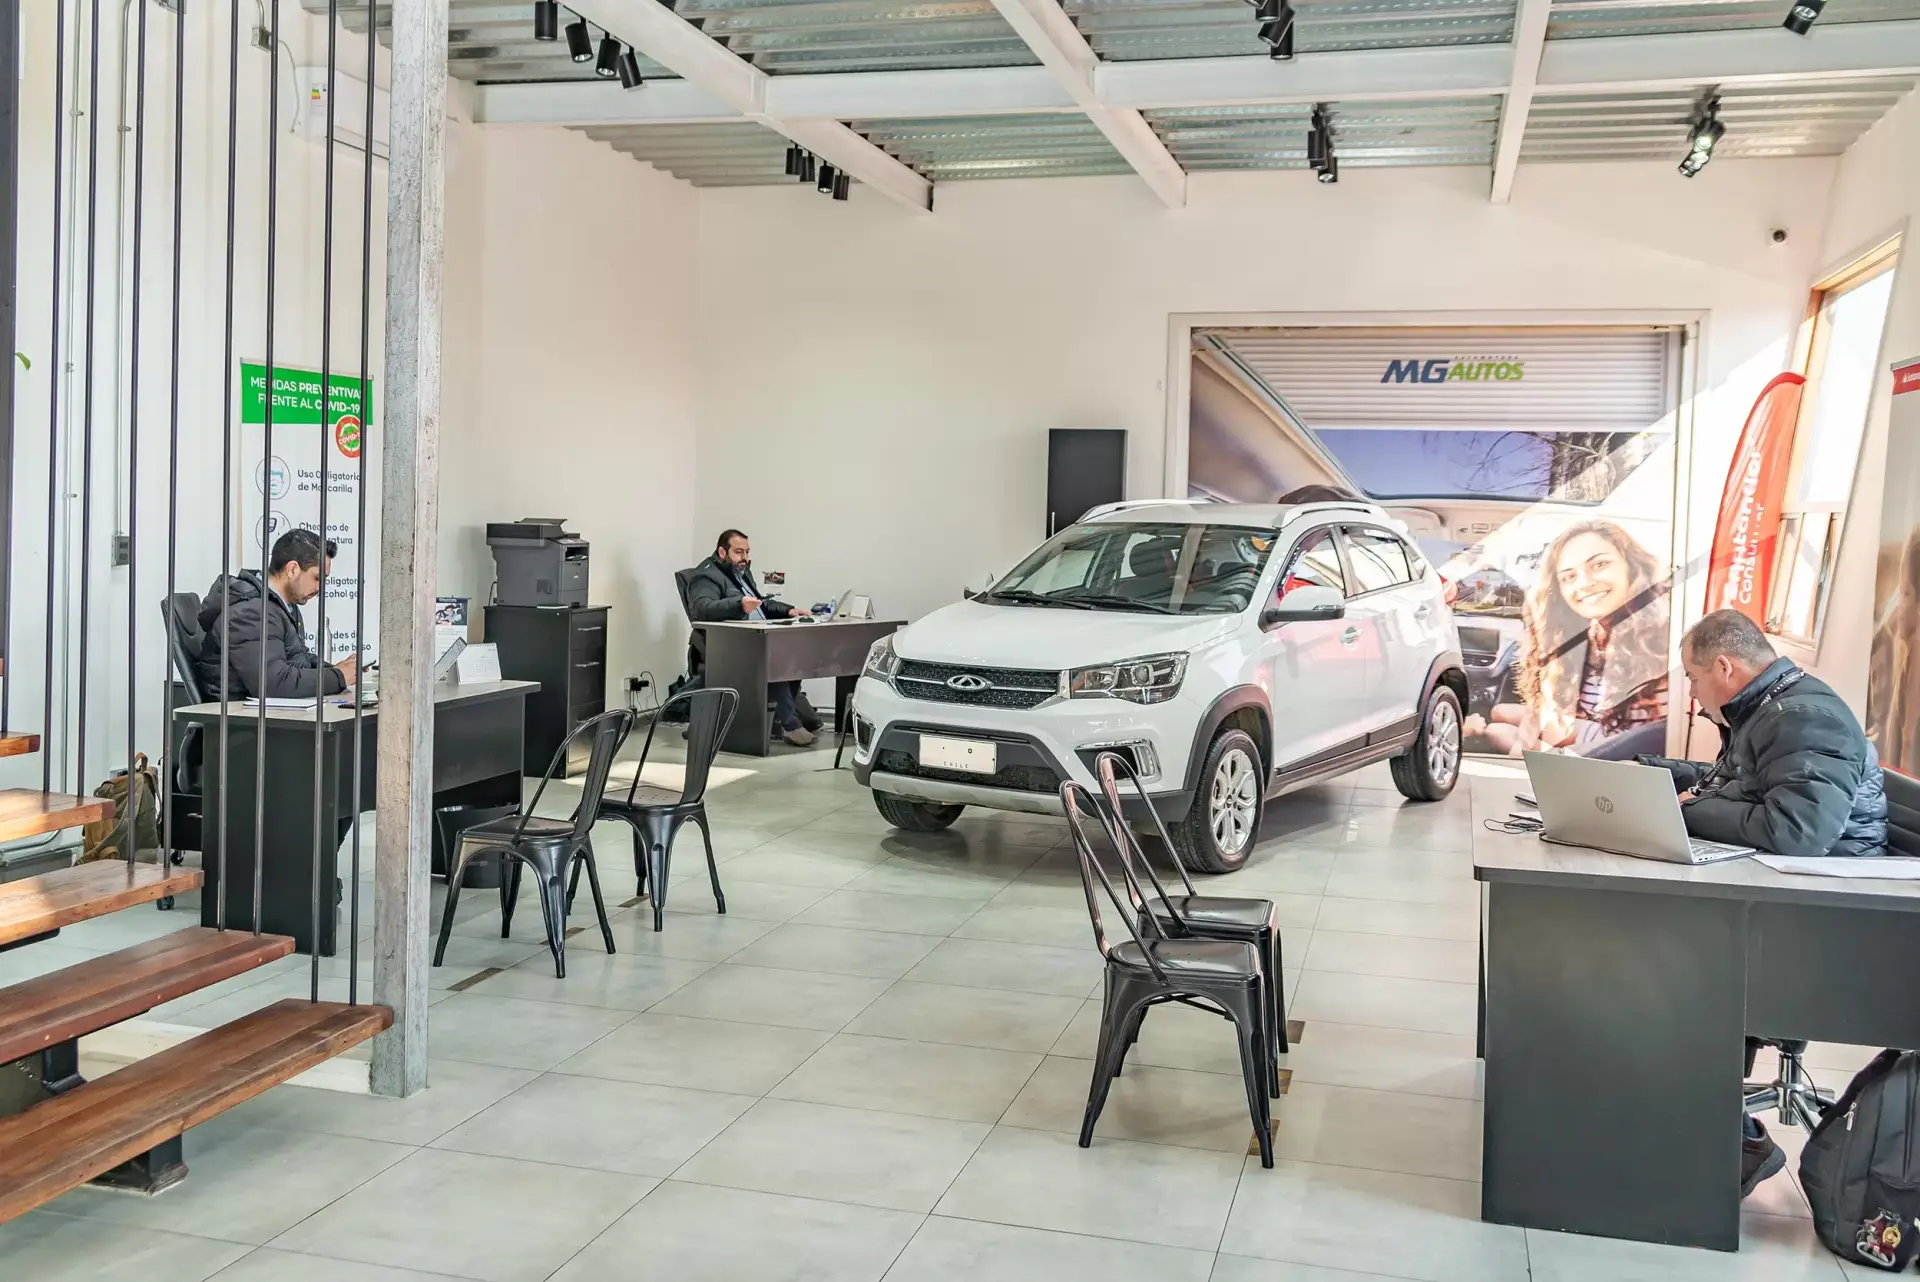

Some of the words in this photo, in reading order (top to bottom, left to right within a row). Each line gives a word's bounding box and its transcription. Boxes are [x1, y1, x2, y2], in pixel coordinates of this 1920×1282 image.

[250, 376, 297, 392] MEIDAS
[258, 393, 298, 408] FENTE
[300, 398, 313, 409] AL
[315, 400, 361, 414] CVID-19
[297, 469, 314, 478] Uso
[315, 470, 361, 482] Oligatorio
[297, 483, 309, 491] de
[312, 483, 353, 493] Macarilla
[339, 523, 349, 532] de
[338, 643, 350, 652] de
[351, 642, 371, 652] bso
